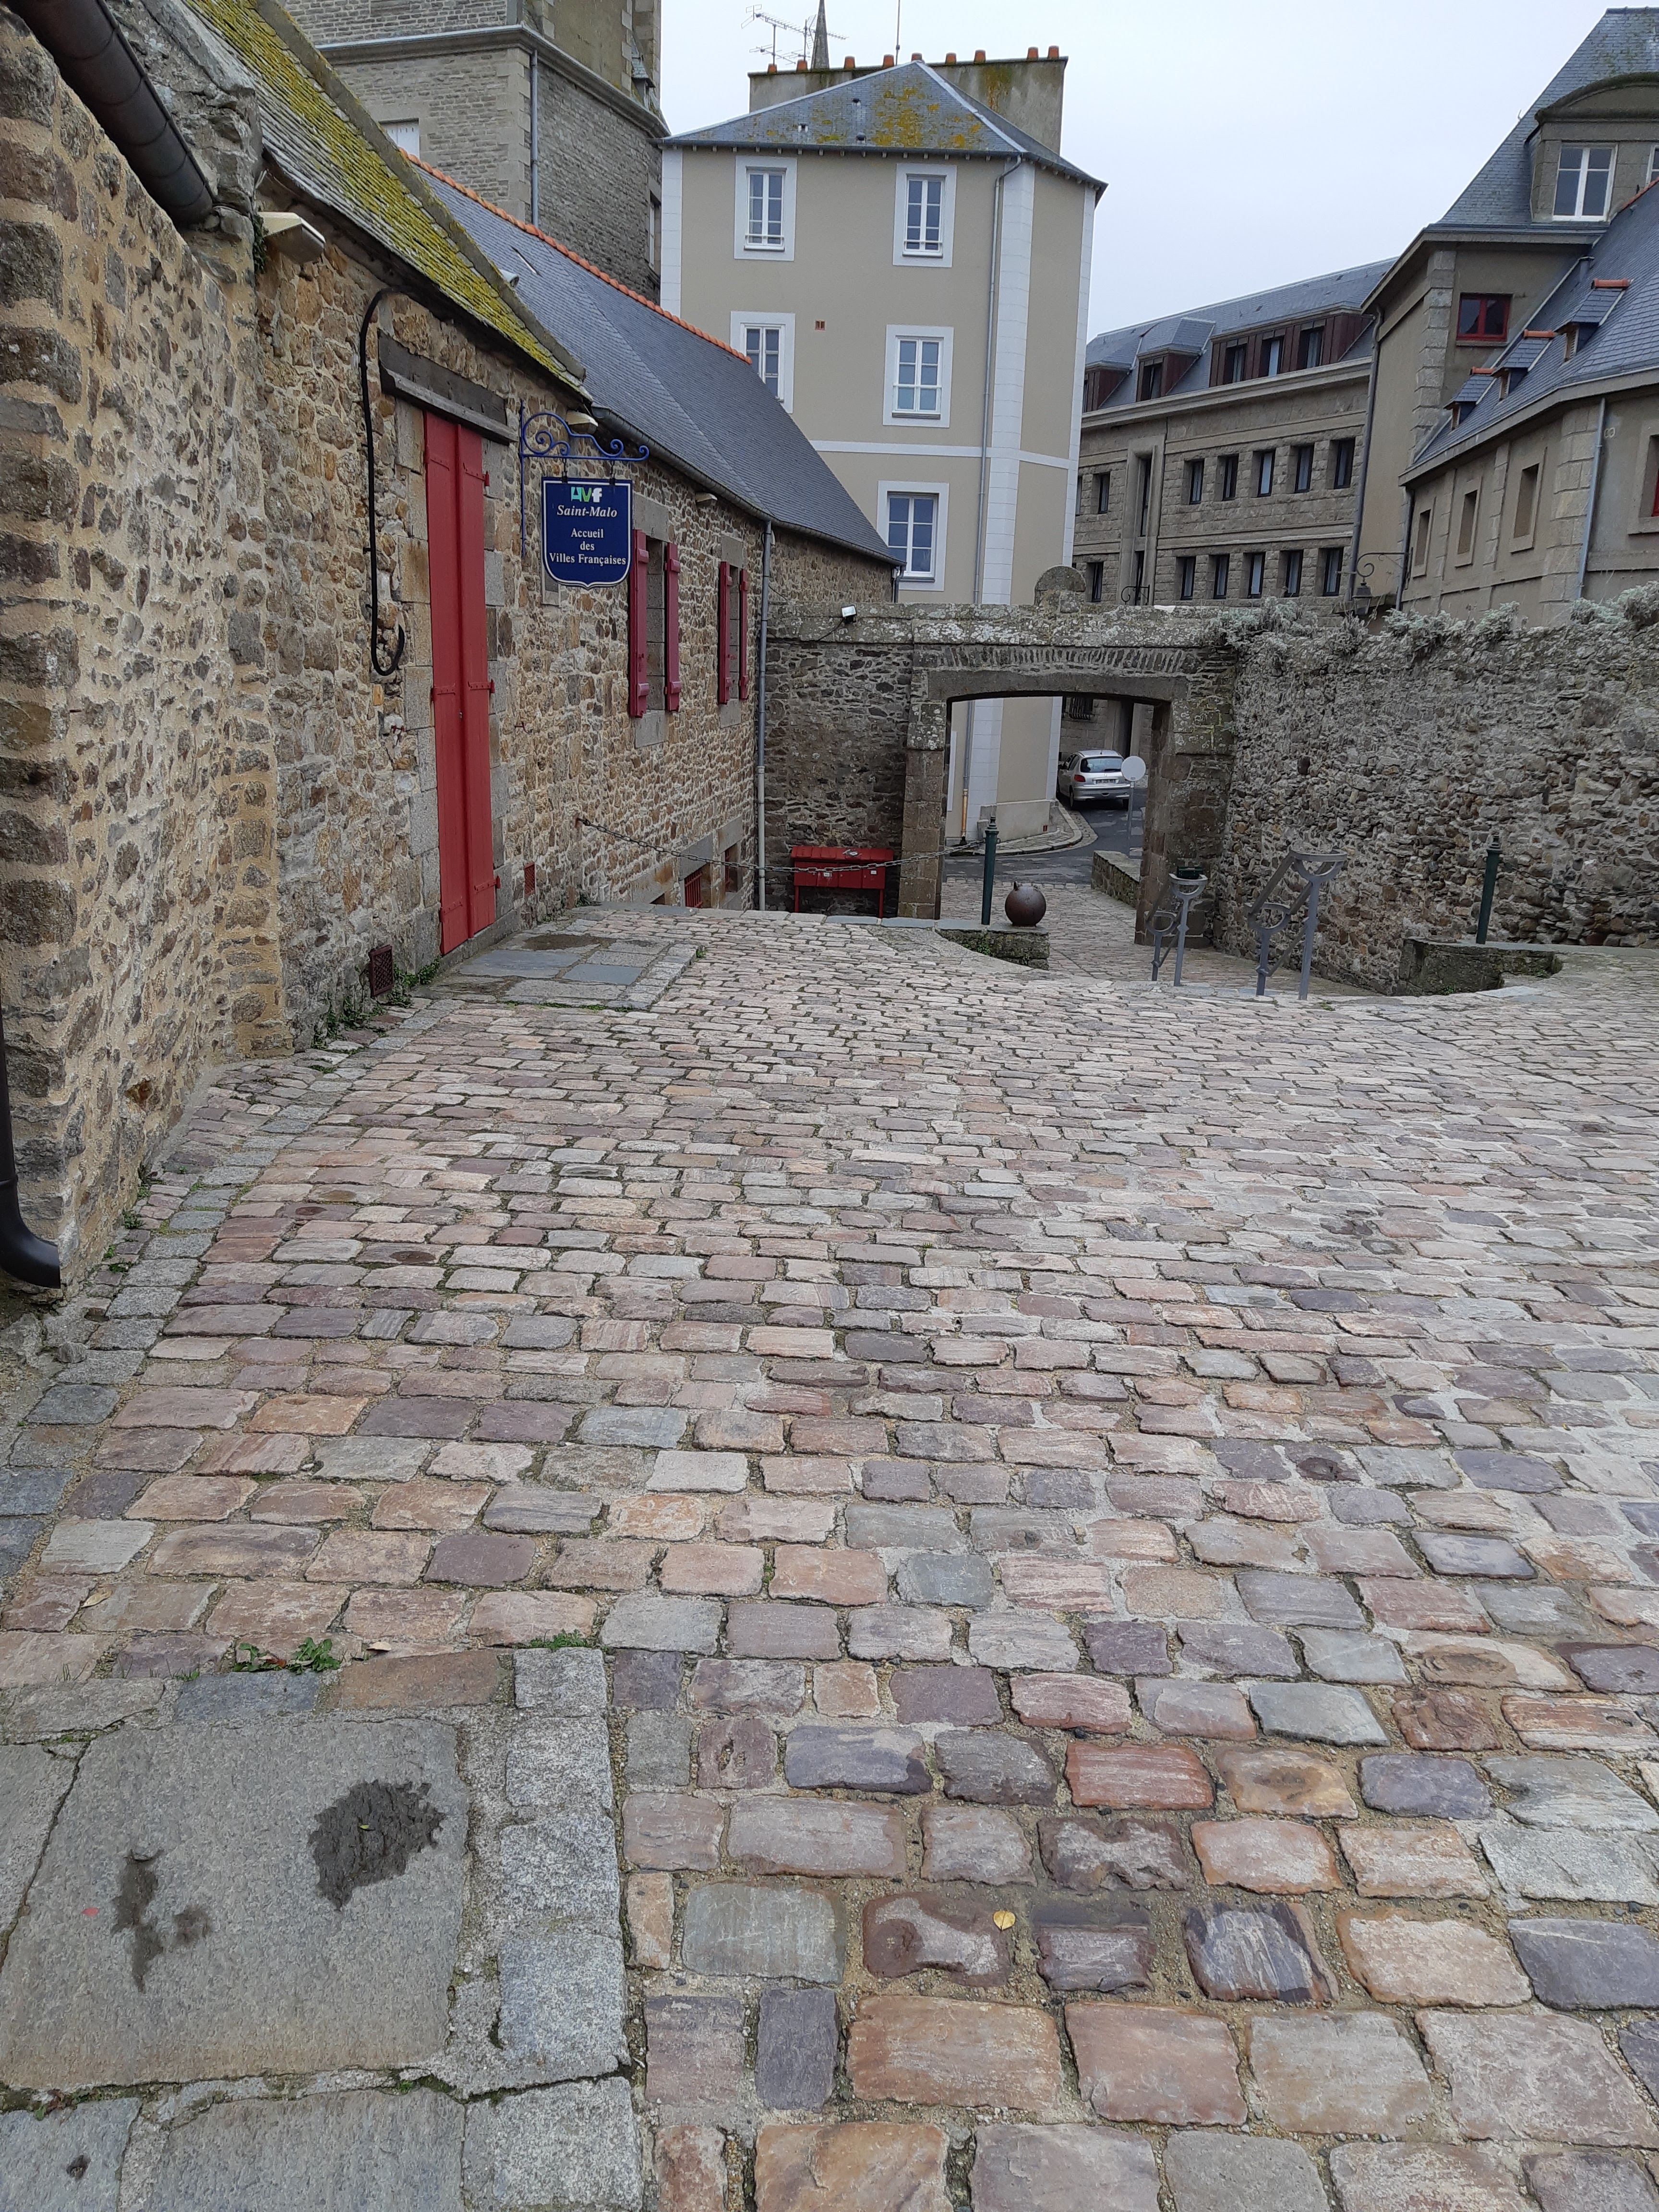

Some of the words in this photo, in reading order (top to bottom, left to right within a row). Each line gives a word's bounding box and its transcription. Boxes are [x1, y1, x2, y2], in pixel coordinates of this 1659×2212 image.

[557, 505, 617, 517] Saint-Malo
[571, 528, 604, 538] Accueil
[580, 541, 595, 551] des
[549, 553, 575, 563] Villes
[578, 553, 626, 566] Françaises
